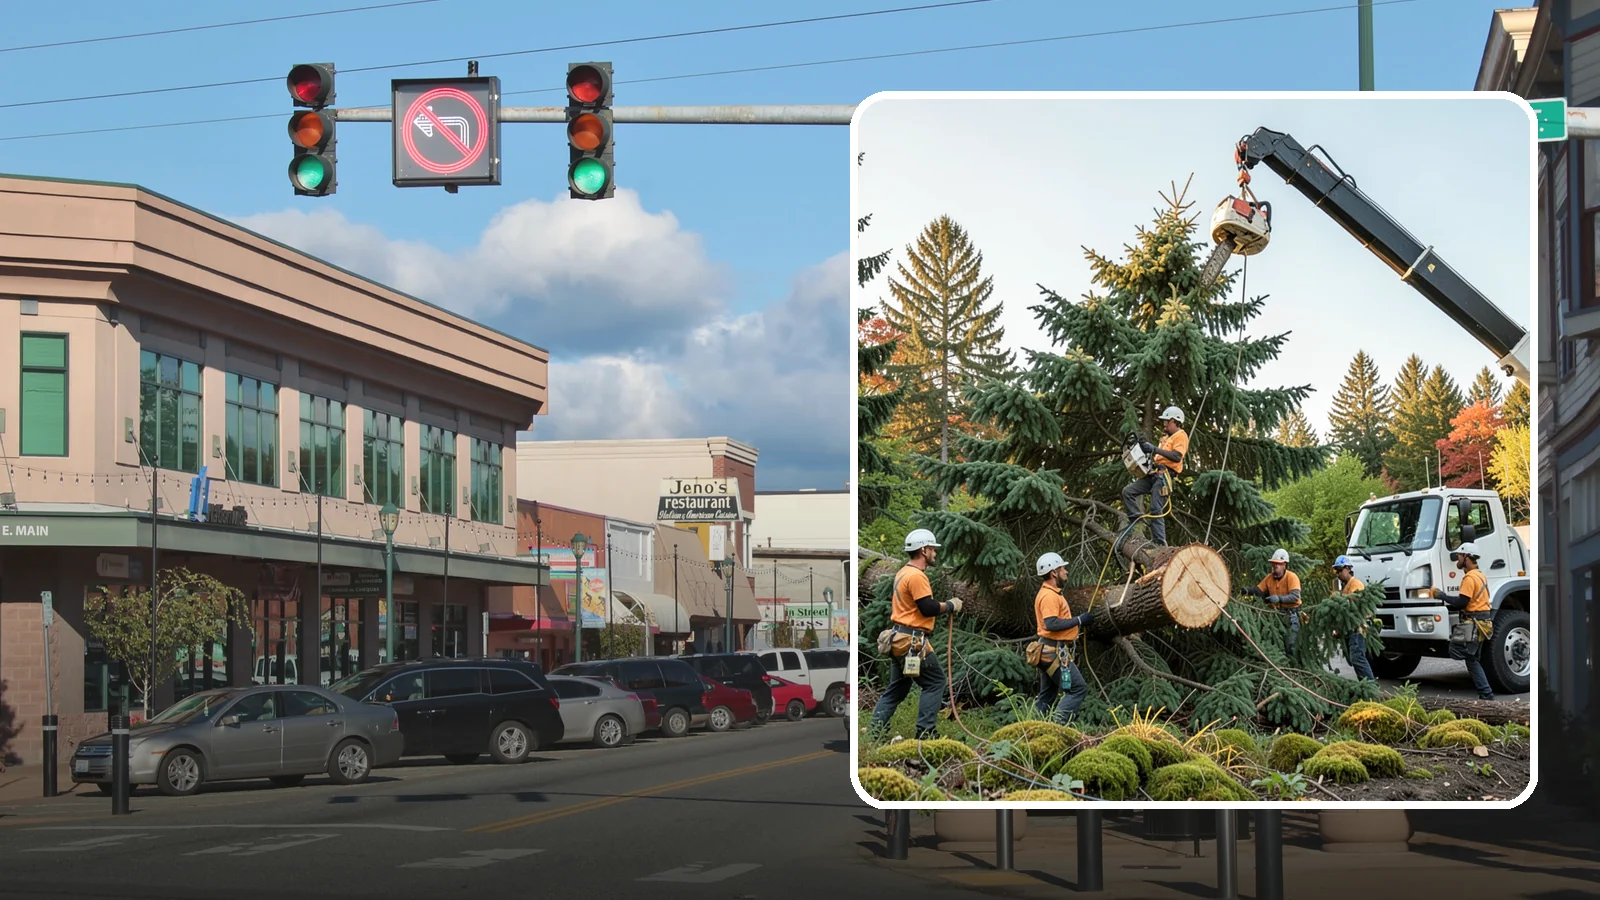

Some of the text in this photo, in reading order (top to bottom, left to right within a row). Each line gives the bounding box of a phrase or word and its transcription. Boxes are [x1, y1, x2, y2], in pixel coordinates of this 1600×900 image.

[670, 480, 727, 494] Jeno's
[665, 496, 731, 509] restaurant
[658, 509, 681, 519] Italian
[686, 509, 714, 519] American
[715, 509, 737, 519] Cuisine
[2, 525, 49, 536] E. MAIN
[797, 607, 828, 617] Street
